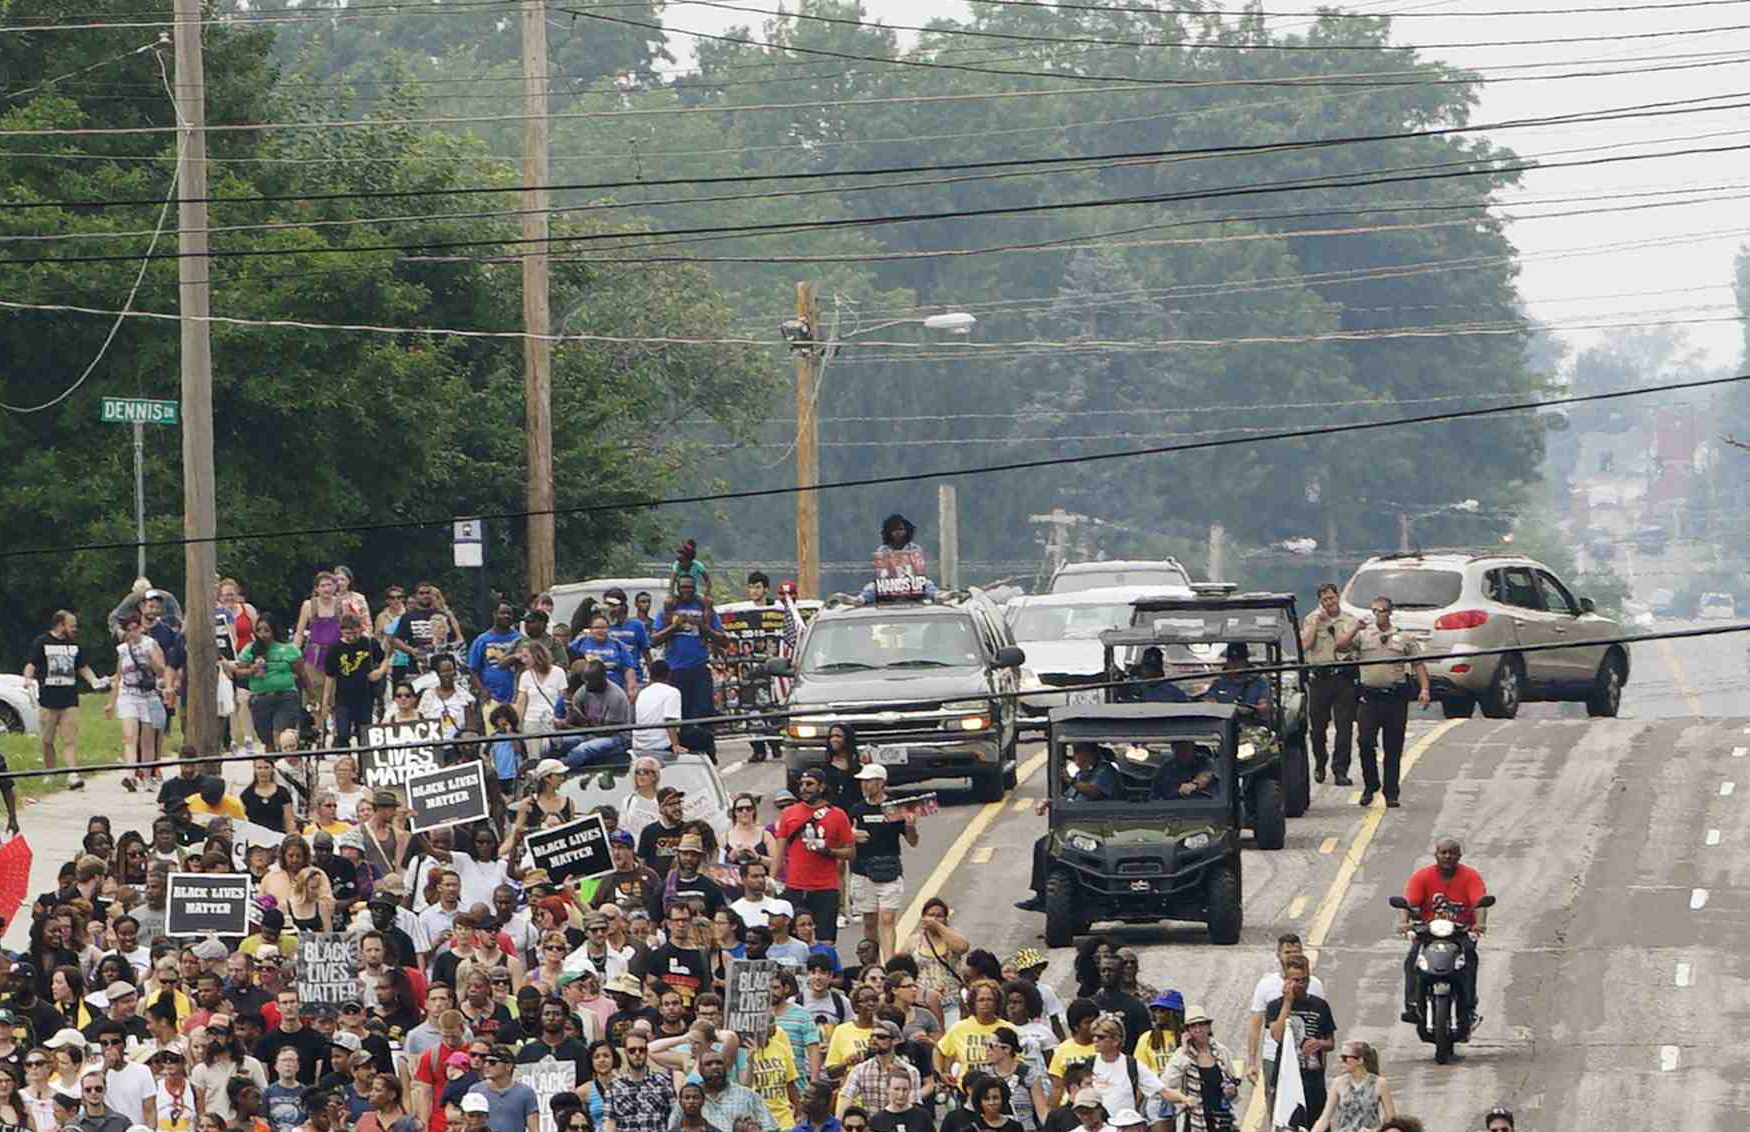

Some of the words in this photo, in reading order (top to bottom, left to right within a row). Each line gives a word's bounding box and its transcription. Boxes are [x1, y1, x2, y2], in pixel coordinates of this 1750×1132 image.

[105, 402, 162, 420] DENNIS
[368, 721, 441, 748] BLACK
[373, 746, 434, 768] LIVES
[412, 781, 446, 798] BLACK
[448, 774, 479, 790] LIVES
[425, 790, 469, 809] MATTER
[532, 838, 568, 858] BLACK
[569, 828, 602, 846] LIVES
[549, 846, 594, 868] MATTER
[173, 886, 208, 898] BLACK
[210, 887, 244, 899] LIVES
[185, 902, 231, 914] MATTER
[304, 941, 348, 962] BLACK
[307, 962, 347, 982] LIVES
[299, 982, 357, 1003] MATTER
